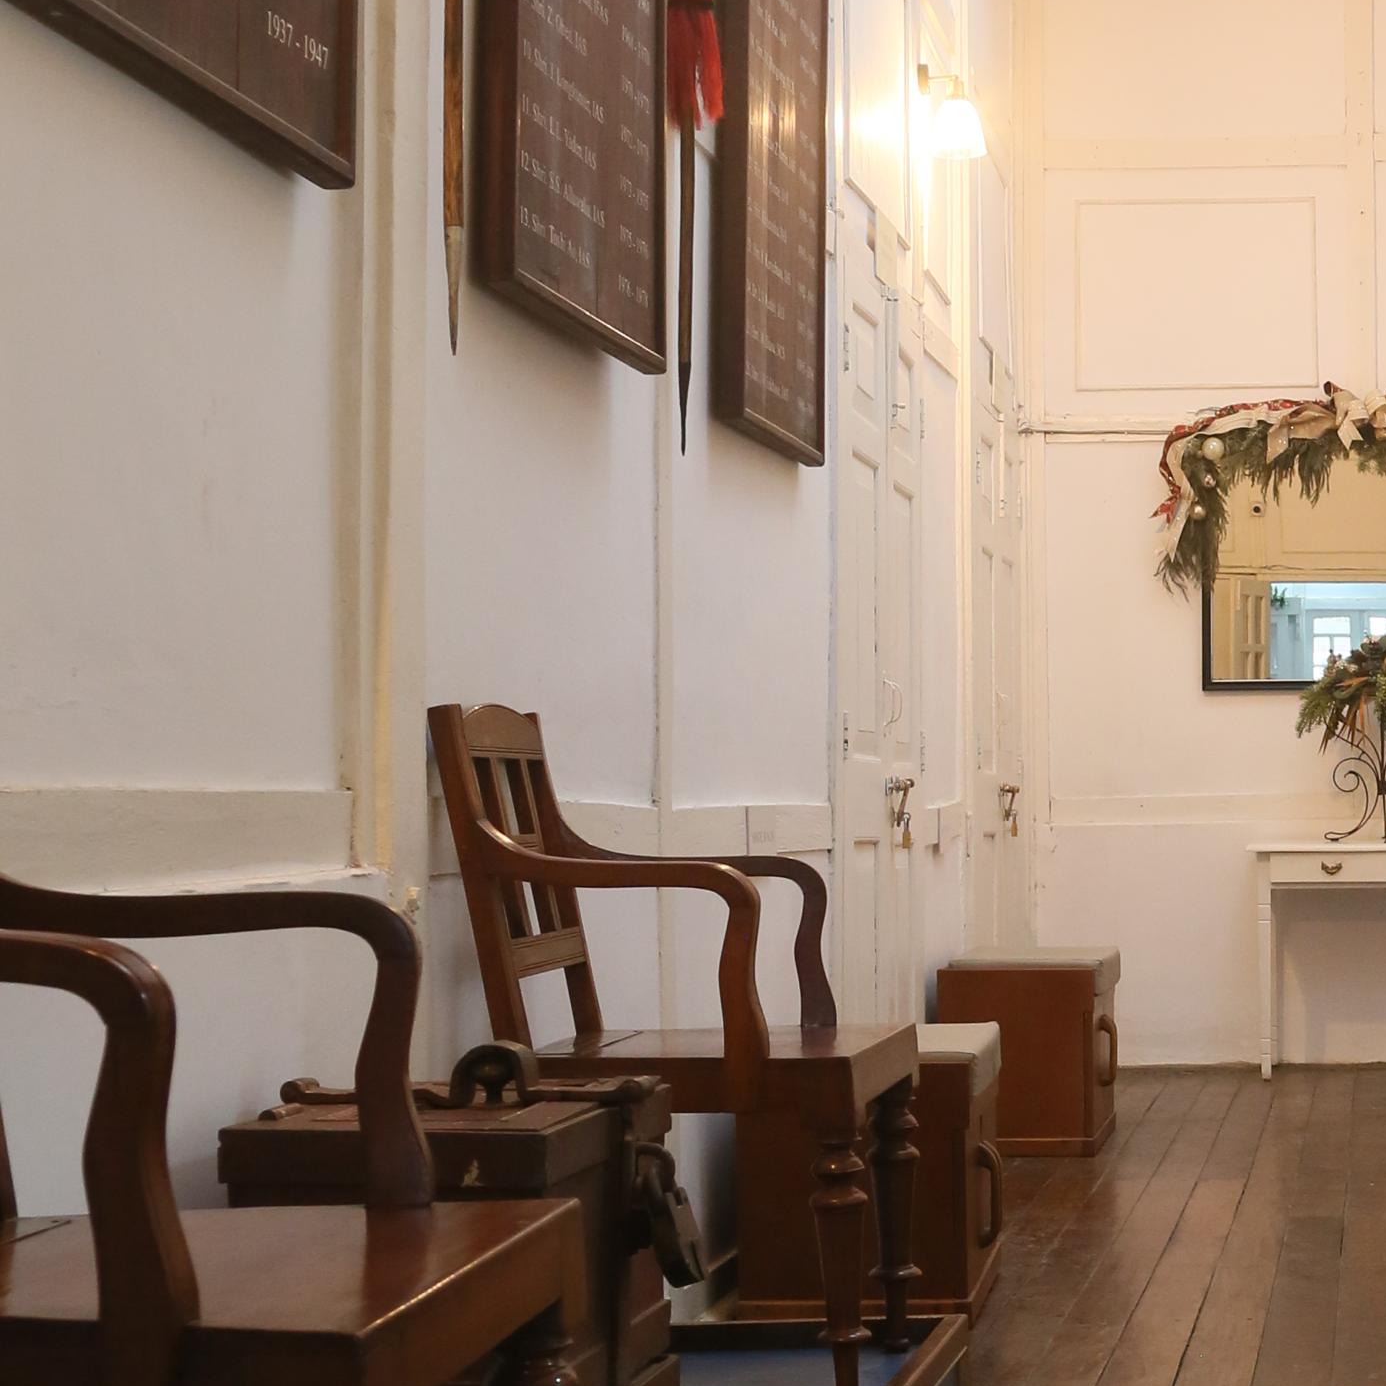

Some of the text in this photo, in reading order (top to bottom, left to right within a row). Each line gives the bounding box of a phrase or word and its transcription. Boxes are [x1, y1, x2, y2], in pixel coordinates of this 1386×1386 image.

[266, 7, 292, 49] 1937
[303, 31, 328, 72] 1947
[592, 97, 604, 126] IAS
[584, 144, 596, 173] IAS
[592, 202, 605, 230] IAS
[578, 243, 590, 269] IAS
